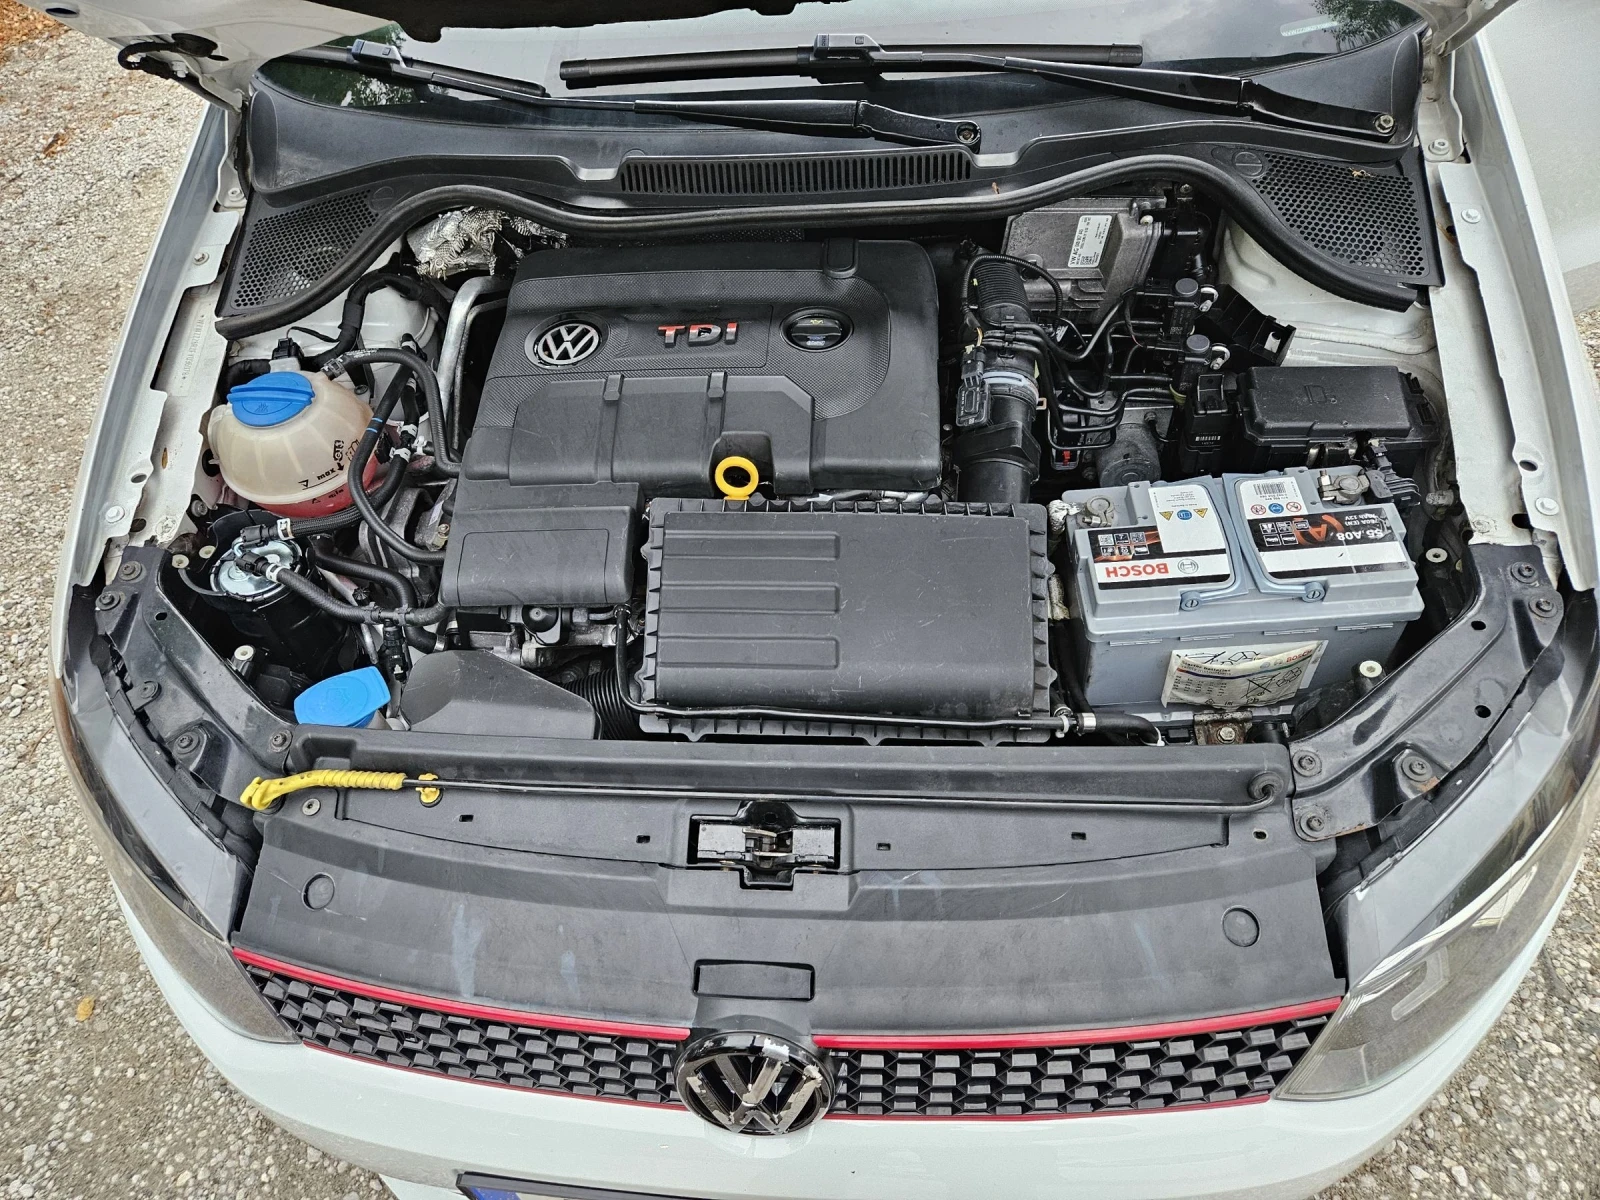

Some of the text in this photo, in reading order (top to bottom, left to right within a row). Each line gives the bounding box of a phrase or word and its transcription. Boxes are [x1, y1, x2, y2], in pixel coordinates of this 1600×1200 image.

[538, 323, 599, 364] VW
[658, 322, 739, 348] TDI
[316, 468, 336, 480] max
[1105, 563, 1169, 578] BOSCH
[680, 1045, 828, 1135] VW
